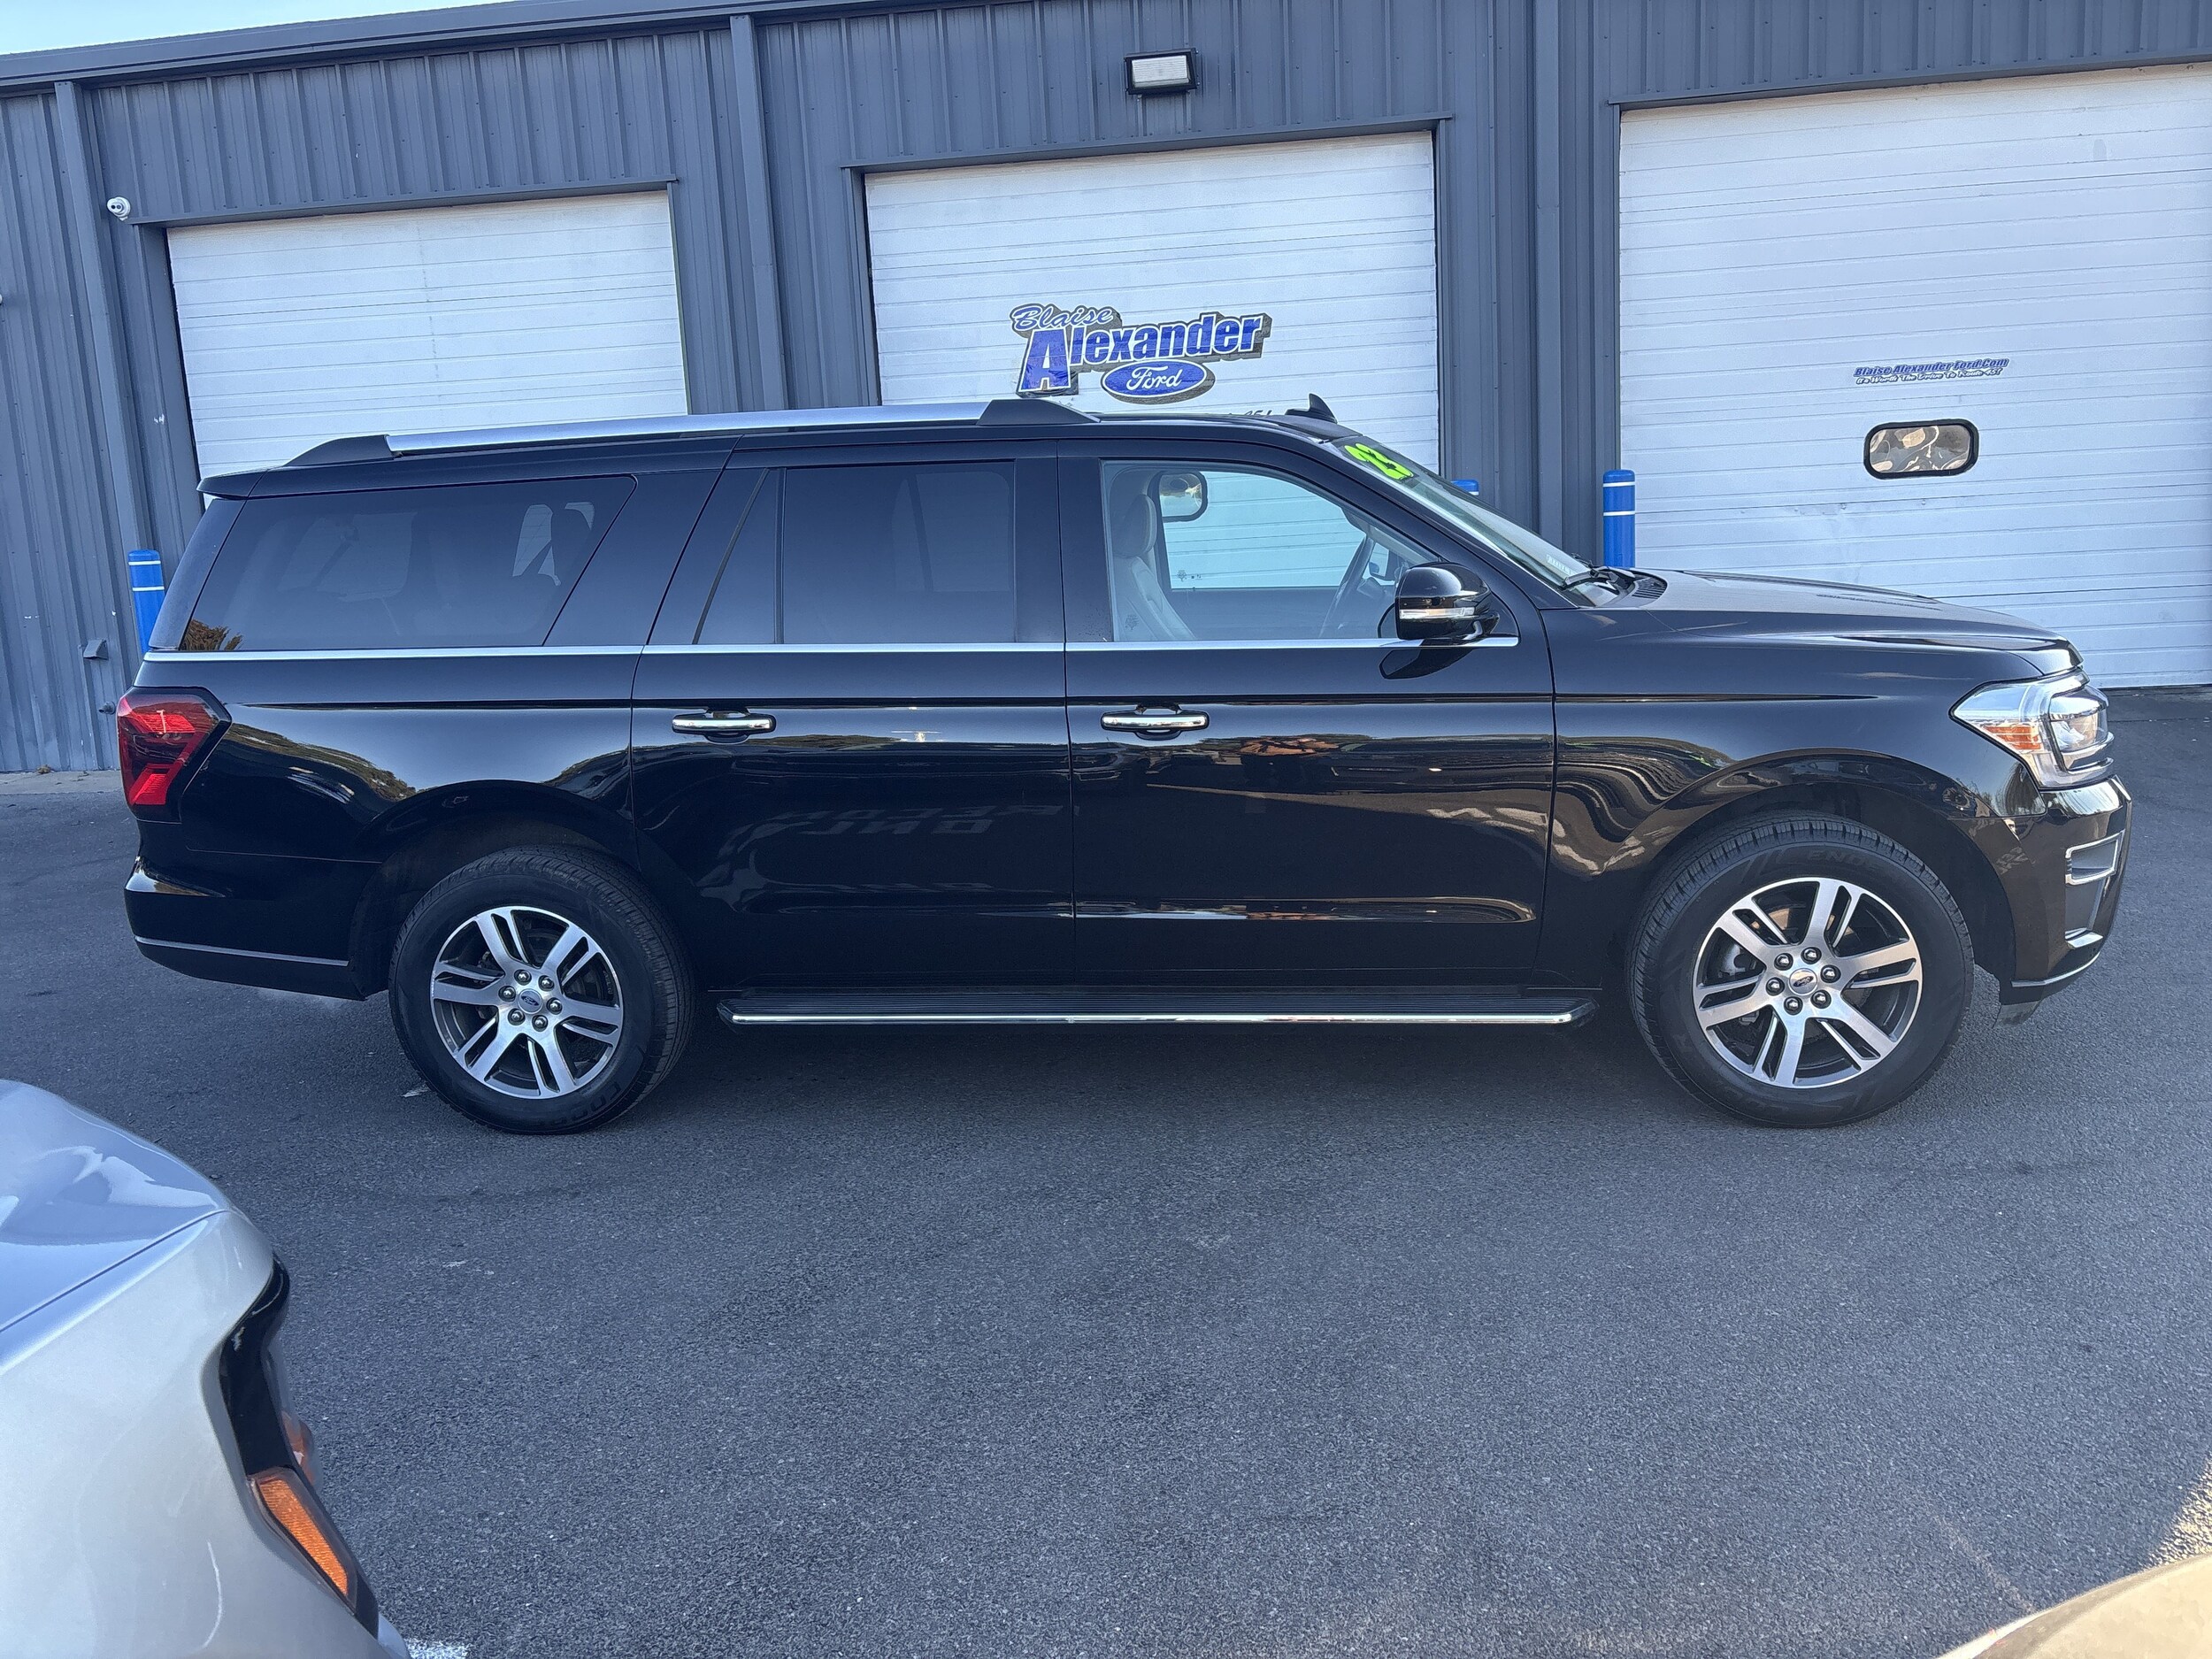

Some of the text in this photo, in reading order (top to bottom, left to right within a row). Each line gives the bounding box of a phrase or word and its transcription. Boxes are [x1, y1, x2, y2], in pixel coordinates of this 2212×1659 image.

[1012, 304, 1114, 332] Blaise
[1018, 313, 1265, 391] Alexander
[1125, 365, 1183, 390] Ford
[1854, 366, 1893, 377] Blaise
[1893, 362, 1953, 375] Alexander
